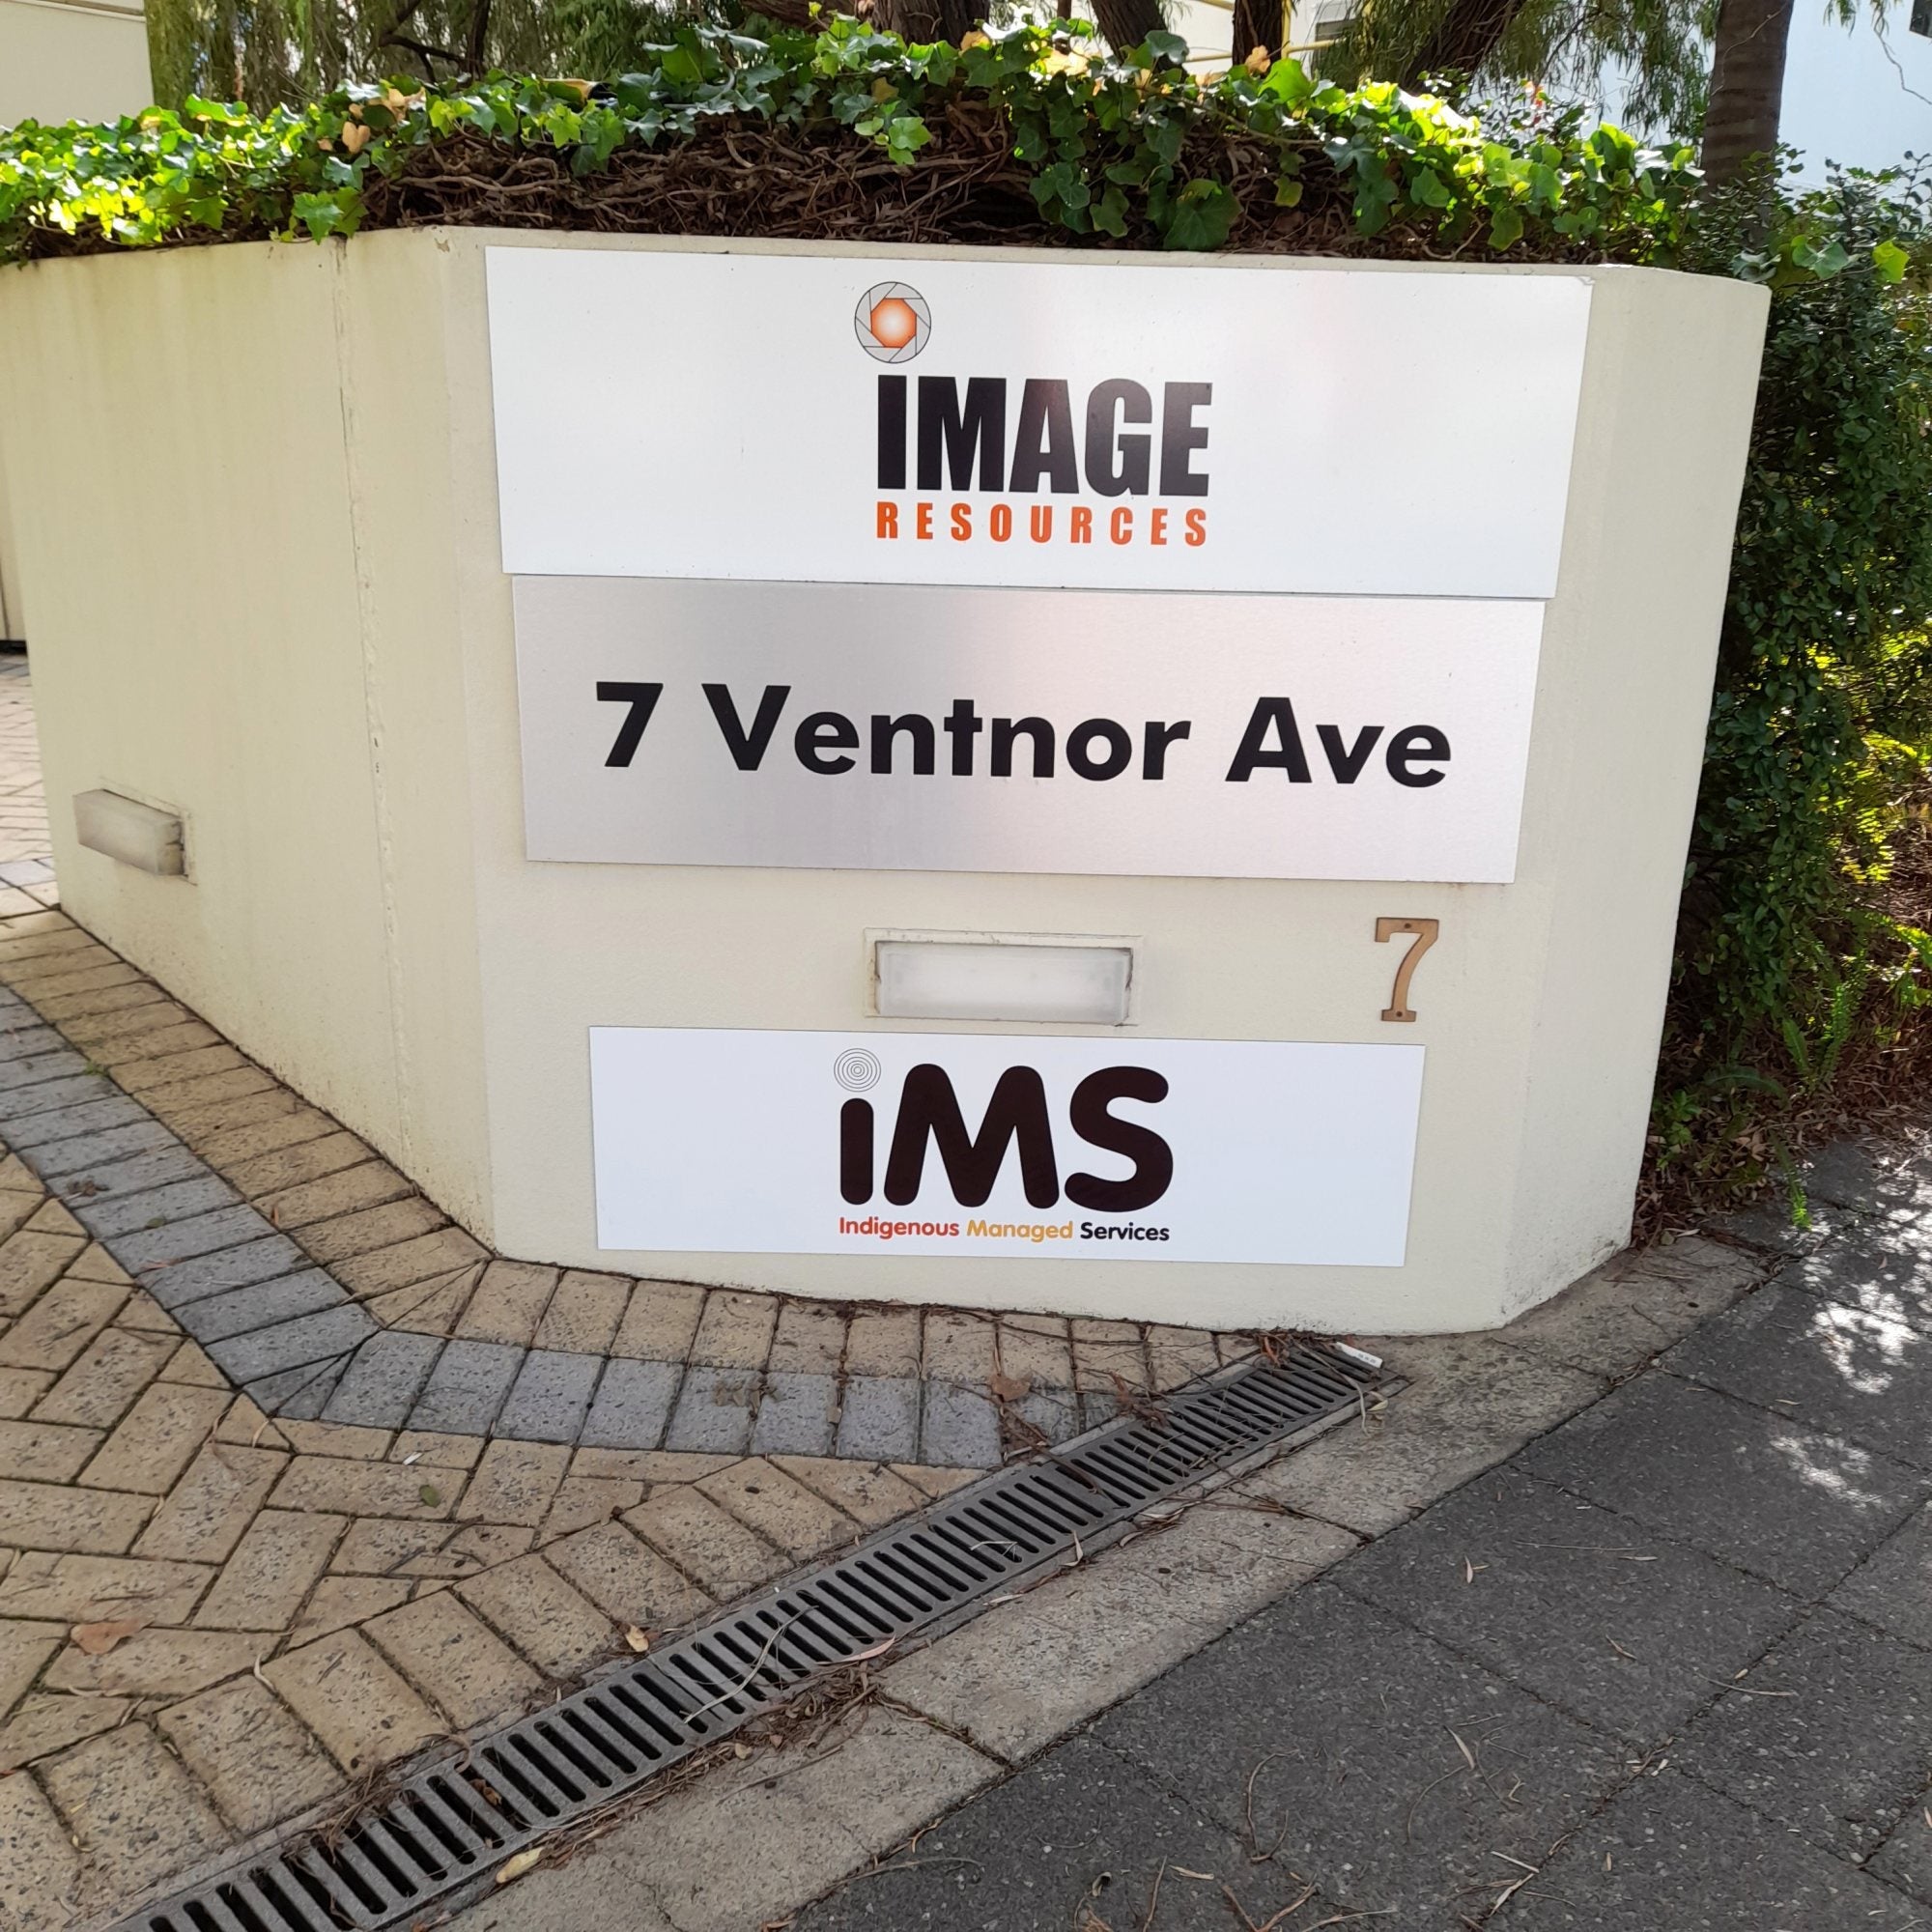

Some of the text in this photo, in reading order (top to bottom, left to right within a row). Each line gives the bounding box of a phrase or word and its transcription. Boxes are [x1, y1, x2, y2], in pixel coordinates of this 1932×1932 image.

[877, 374, 1213, 497] IMAGE
[876, 501, 1207, 547] RESOURCES
[596, 681, 1451, 788] 7 Ventnor Ave
[1375, 917, 1439, 1023] 7
[838, 1216, 1170, 1243] Indigenous Managed Services
